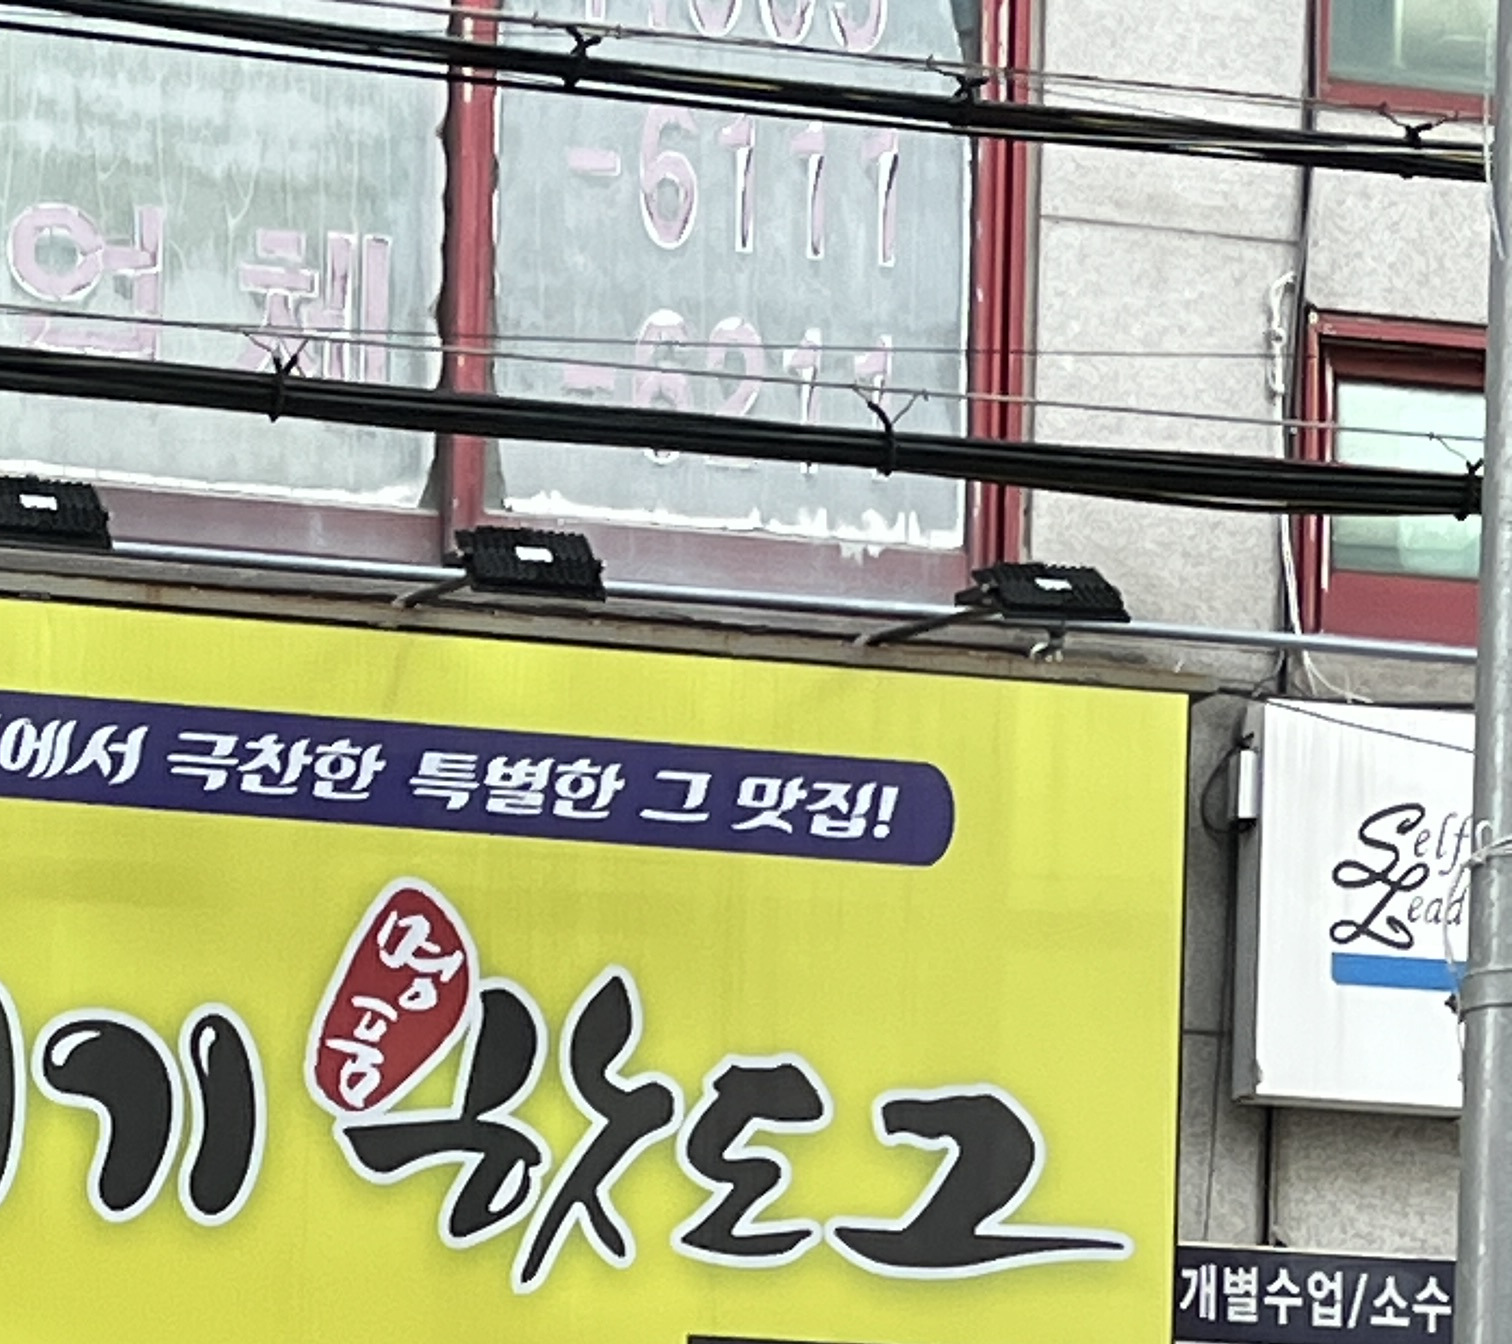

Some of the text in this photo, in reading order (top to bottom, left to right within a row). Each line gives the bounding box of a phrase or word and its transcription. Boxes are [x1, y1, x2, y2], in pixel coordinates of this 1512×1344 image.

[167, 730, 387, 800] 극찬한
[409, 750, 626, 820] 특별한
[639, 770, 713, 823] 그
[731, 776, 900, 840] 맛집!
[343, 976, 1126, 1284] 핫도그
